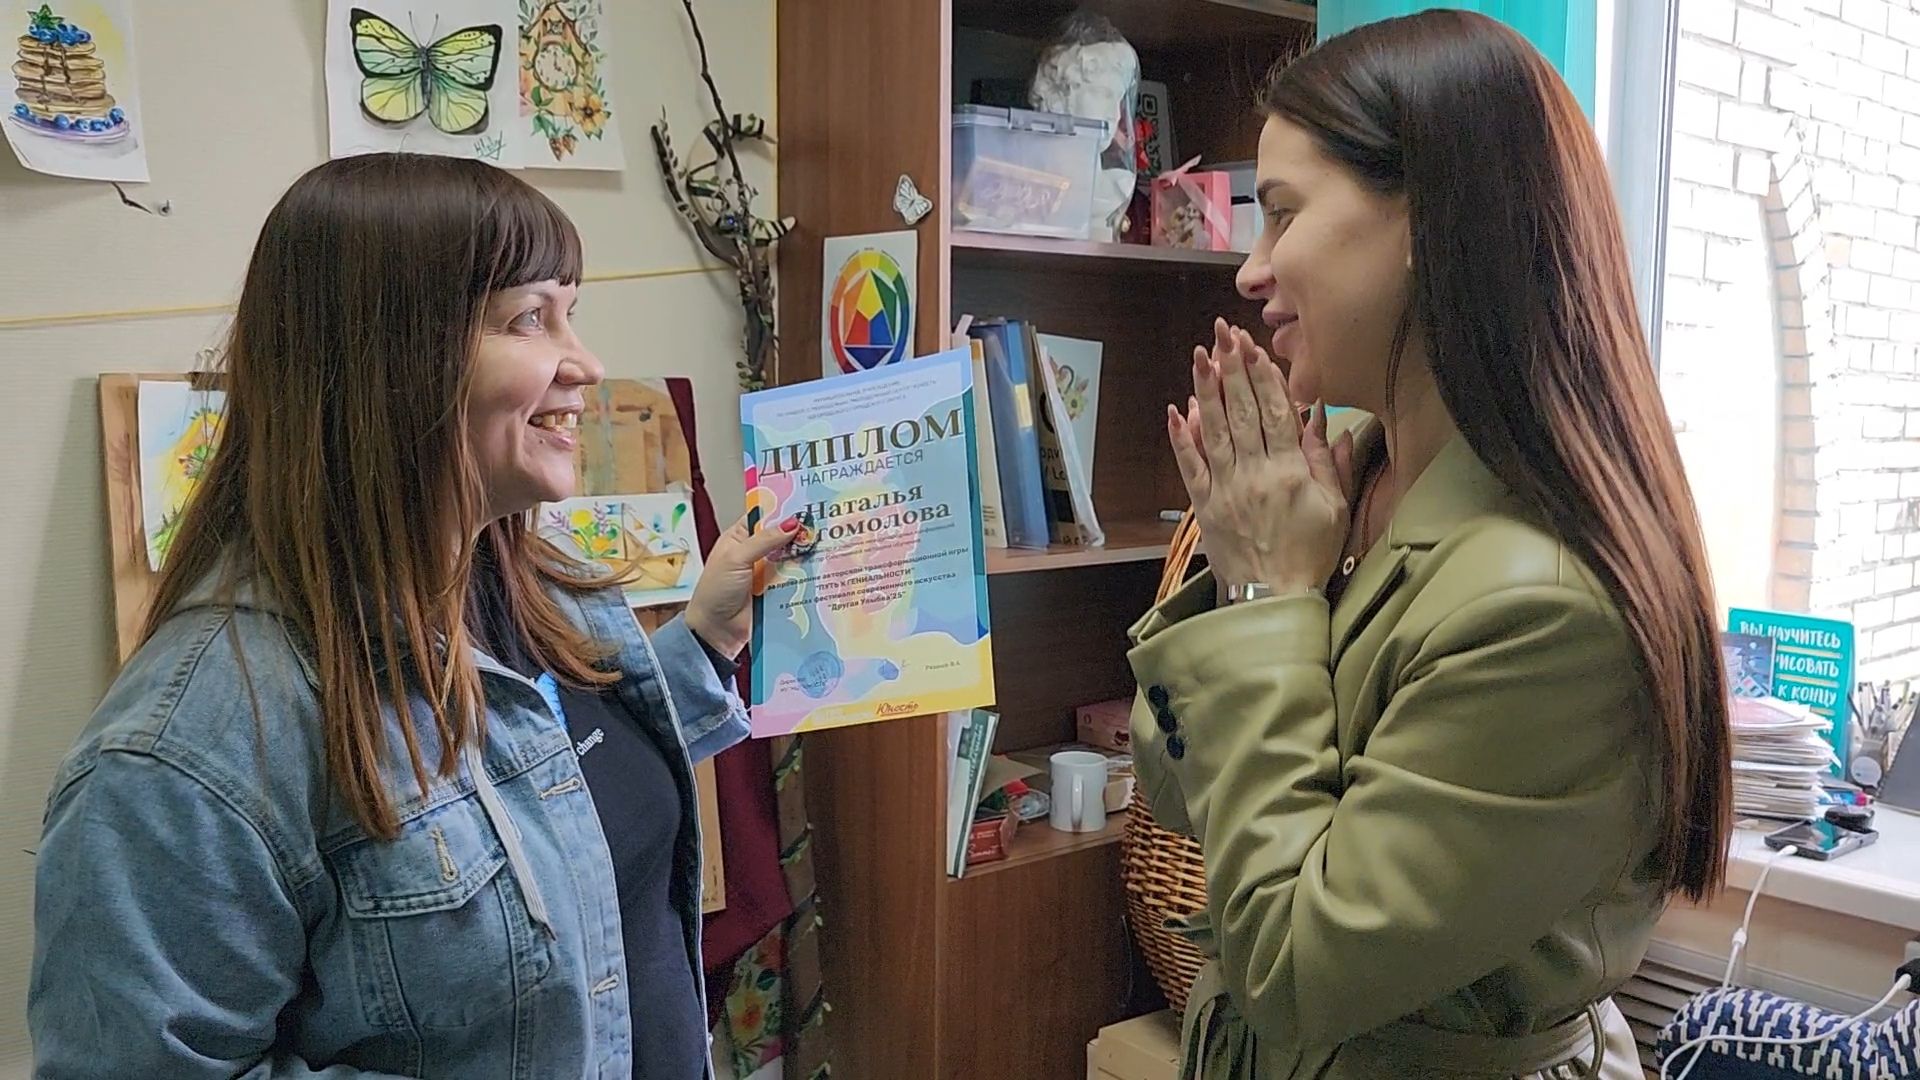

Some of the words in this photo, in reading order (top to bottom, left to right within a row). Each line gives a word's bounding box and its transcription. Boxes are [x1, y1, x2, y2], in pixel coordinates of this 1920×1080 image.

[758, 408, 963, 481] ДИПЛОМ
[800, 449, 924, 487] НАГРАЖДАЕТСЯ
[804, 484, 924, 521] Наталья
[816, 503, 952, 542] гомолова
[948, 547, 969, 559] игры
[914, 571, 957, 587] искусства
[1740, 621, 1763, 637] ВЫ
[1767, 625, 1841, 648] НАУЧИТЕСЬ
[1776, 654, 1839, 678] ИСОВАТЬ
[1777, 684, 1788, 697] К
[1791, 686, 1837, 708] КОНЦУ
[576, 727, 605, 756] change
